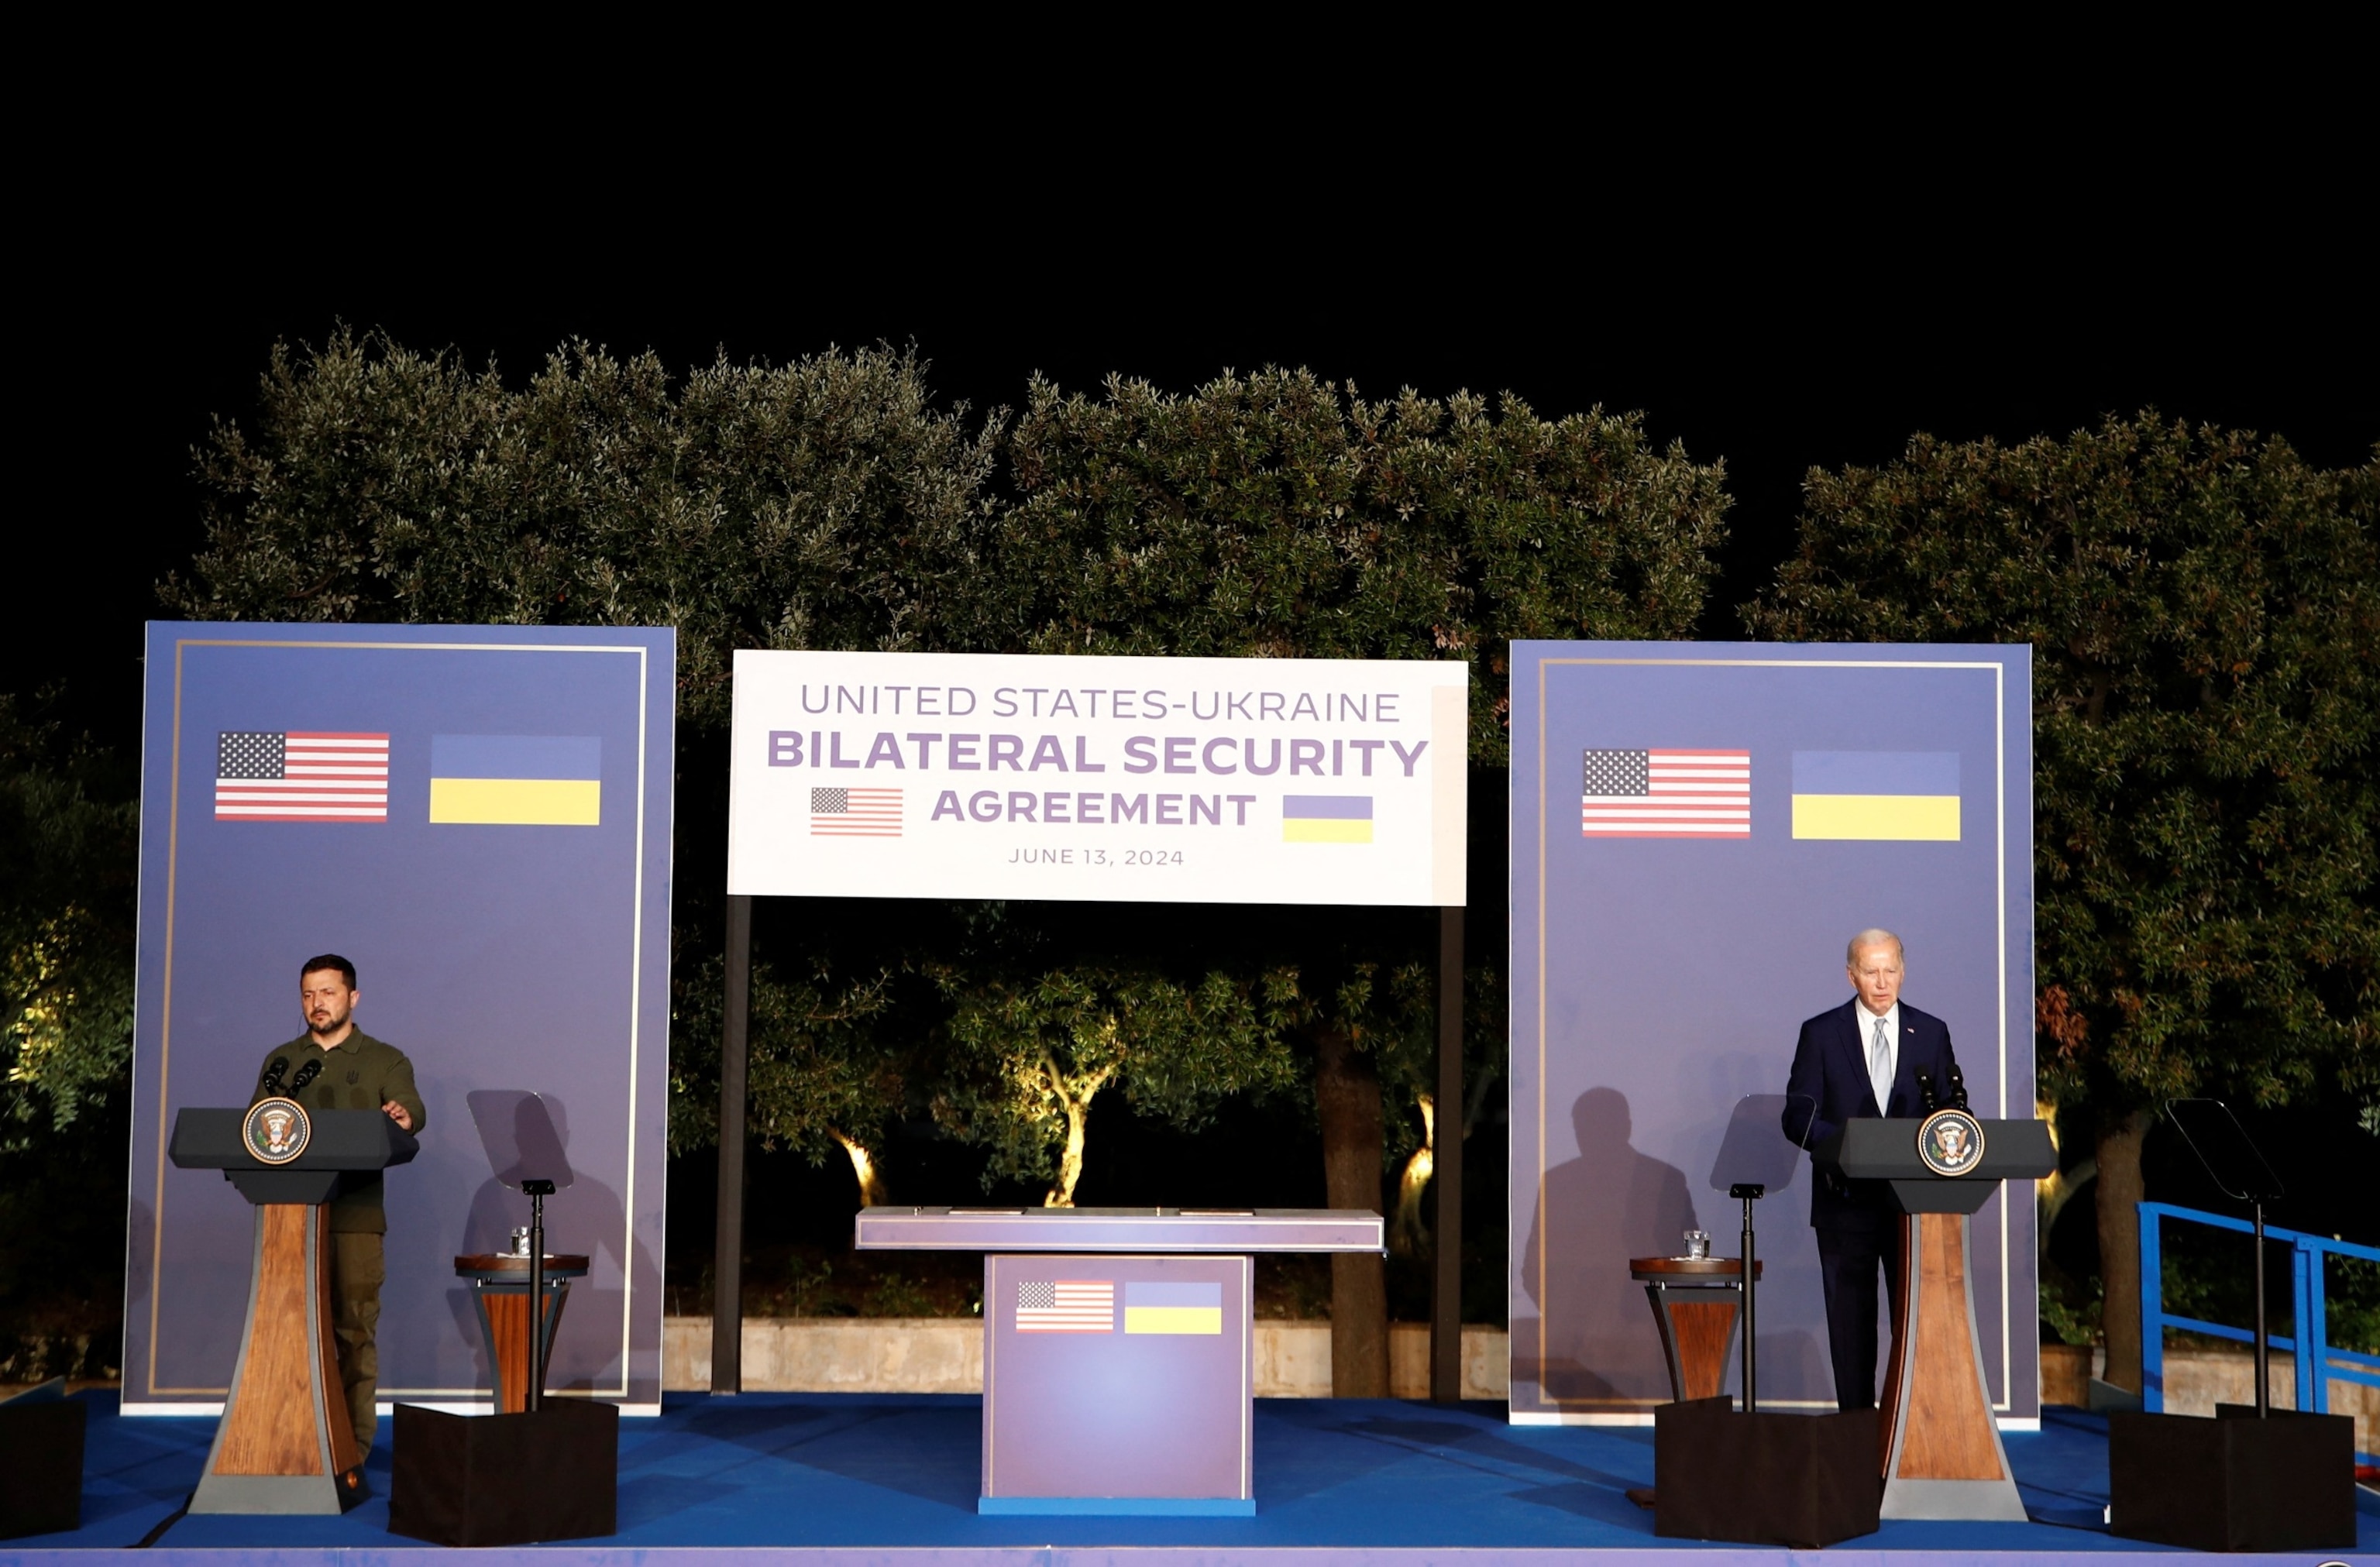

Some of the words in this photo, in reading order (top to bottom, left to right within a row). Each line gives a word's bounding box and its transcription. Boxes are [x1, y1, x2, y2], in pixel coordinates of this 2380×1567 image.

[801, 684, 977, 716] UNITED
[992, 687, 1400, 723] STATES-UKRAINE
[768, 730, 1106, 773] BILATERAL
[1123, 736, 1429, 778] SECURITY
[930, 789, 1257, 826] AGREEMENT
[1008, 848, 1073, 864] JUNE
[1084, 849, 1114, 868] 13,
[1124, 850, 1184, 866] 2024
